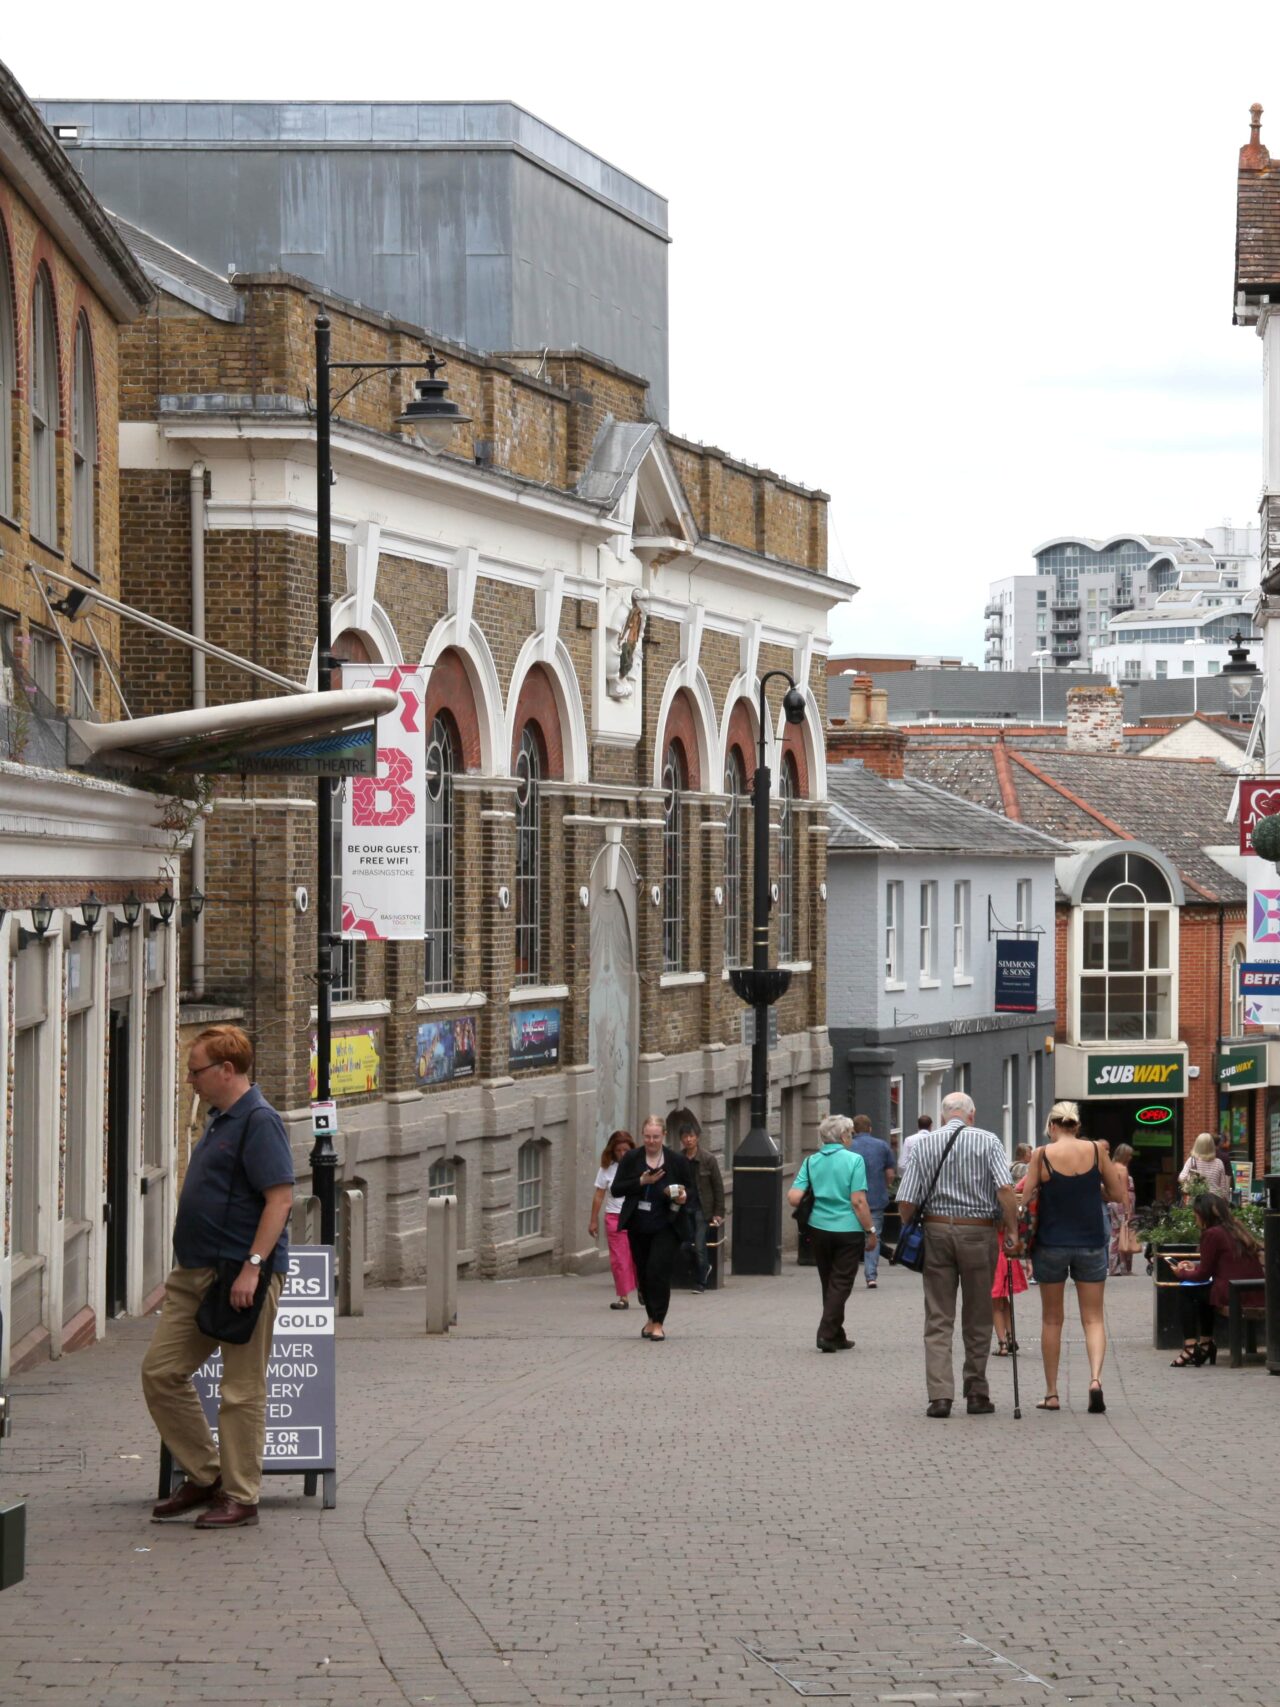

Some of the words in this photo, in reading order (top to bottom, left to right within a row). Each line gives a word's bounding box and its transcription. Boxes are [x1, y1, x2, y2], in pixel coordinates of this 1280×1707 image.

[237, 758, 312, 772] HAYMARKET
[317, 758, 367, 773] THEATRE
[347, 845, 361, 854] BE
[362, 845, 384, 854] OUR
[385, 845, 421, 854] GUEST.
[359, 856, 384, 865] FREE
[386, 856, 409, 865] WIFI
[998, 960, 1036, 969] SIMMONS
[1002, 968, 1009, 976] &
[1009, 968, 1031, 976] SONS
[1095, 1063, 1179, 1085] SUBWAY
[1220, 1059, 1254, 1078] SUBWAY
[1140, 1109, 1168, 1120] OPEN
[278, 1314, 328, 1328] GOLD
[278, 1432, 300, 1443] OR
